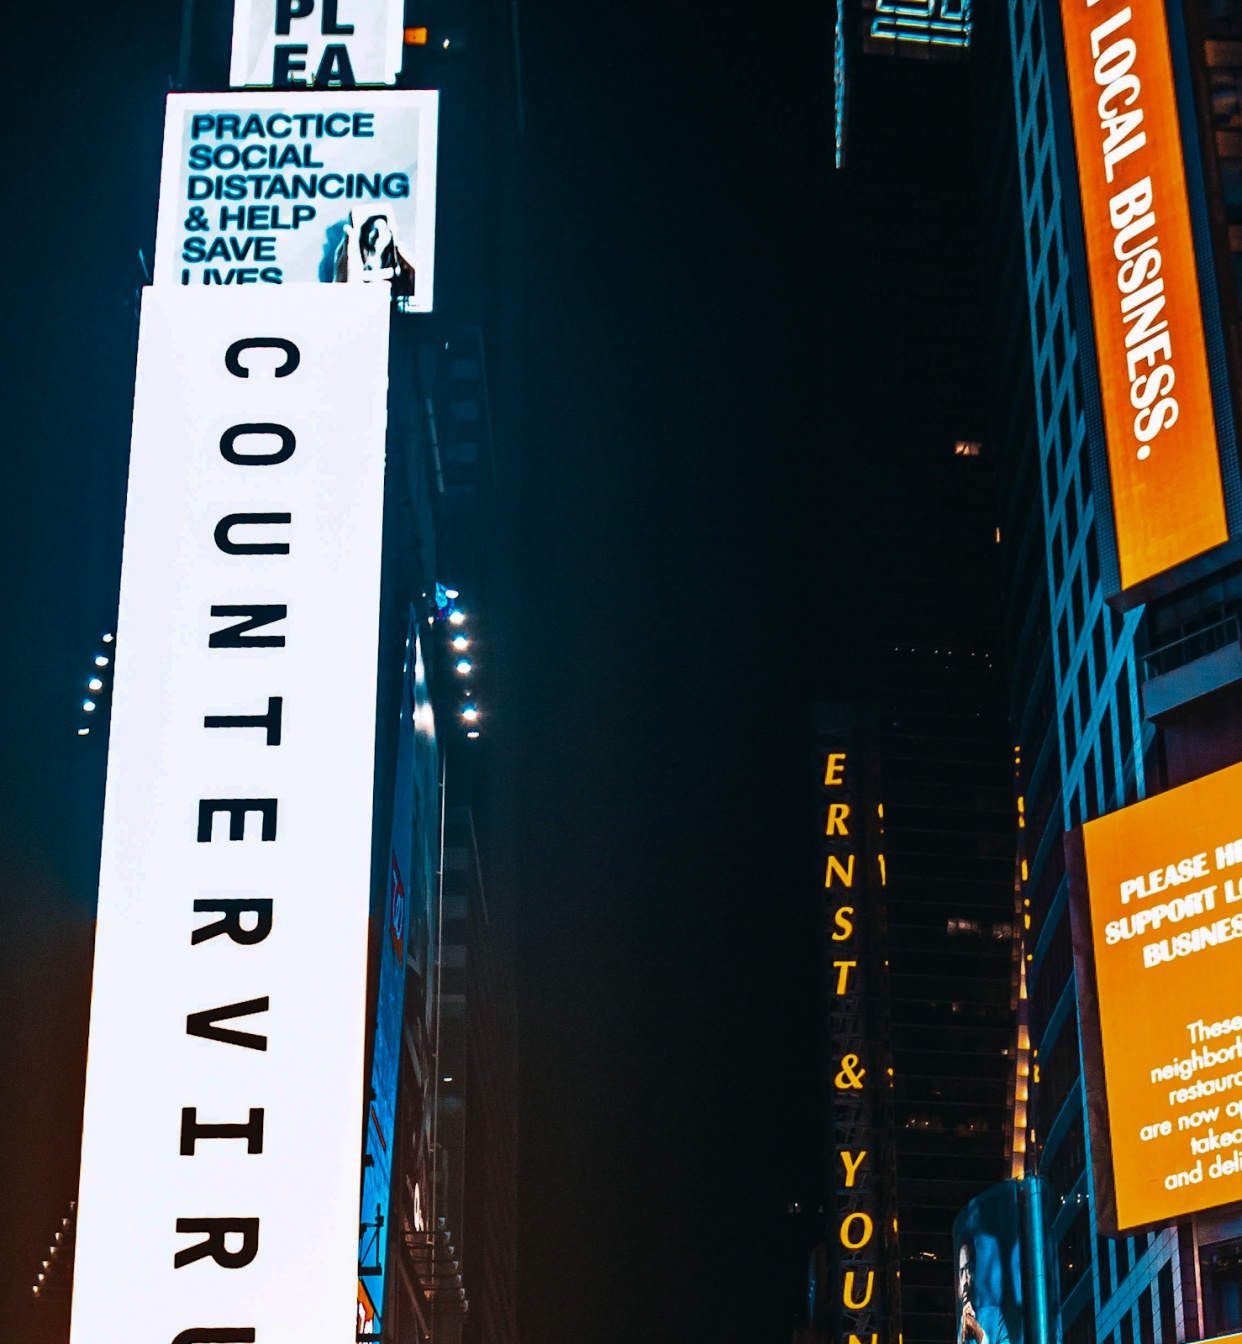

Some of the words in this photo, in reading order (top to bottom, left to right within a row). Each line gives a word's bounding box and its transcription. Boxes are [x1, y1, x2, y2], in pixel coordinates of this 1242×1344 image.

[275, 0, 354, 35] PL
[273, 44, 356, 86] EA
[1090, 7, 1147, 183] LOCAL
[191, 113, 375, 139] PRACTICE
[188, 144, 324, 170] SOCIAL
[187, 173, 409, 200] DISTANCING
[184, 206, 210, 231] &
[219, 205, 316, 230] HELP
[181, 236, 277, 262] SAVE
[1108, 176, 1179, 462] BUSINESS.
[824, 753, 856, 995] ERNST
[1120, 852, 1210, 904] PLEASE
[1105, 885, 1218, 945] SUPPORT
[1186, 1015, 1242, 1044] These
[834, 1053, 866, 1090] &
[1139, 1120, 1172, 1141] are
[1178, 1106, 1220, 1131] now
[1165, 1159, 1203, 1190] and
